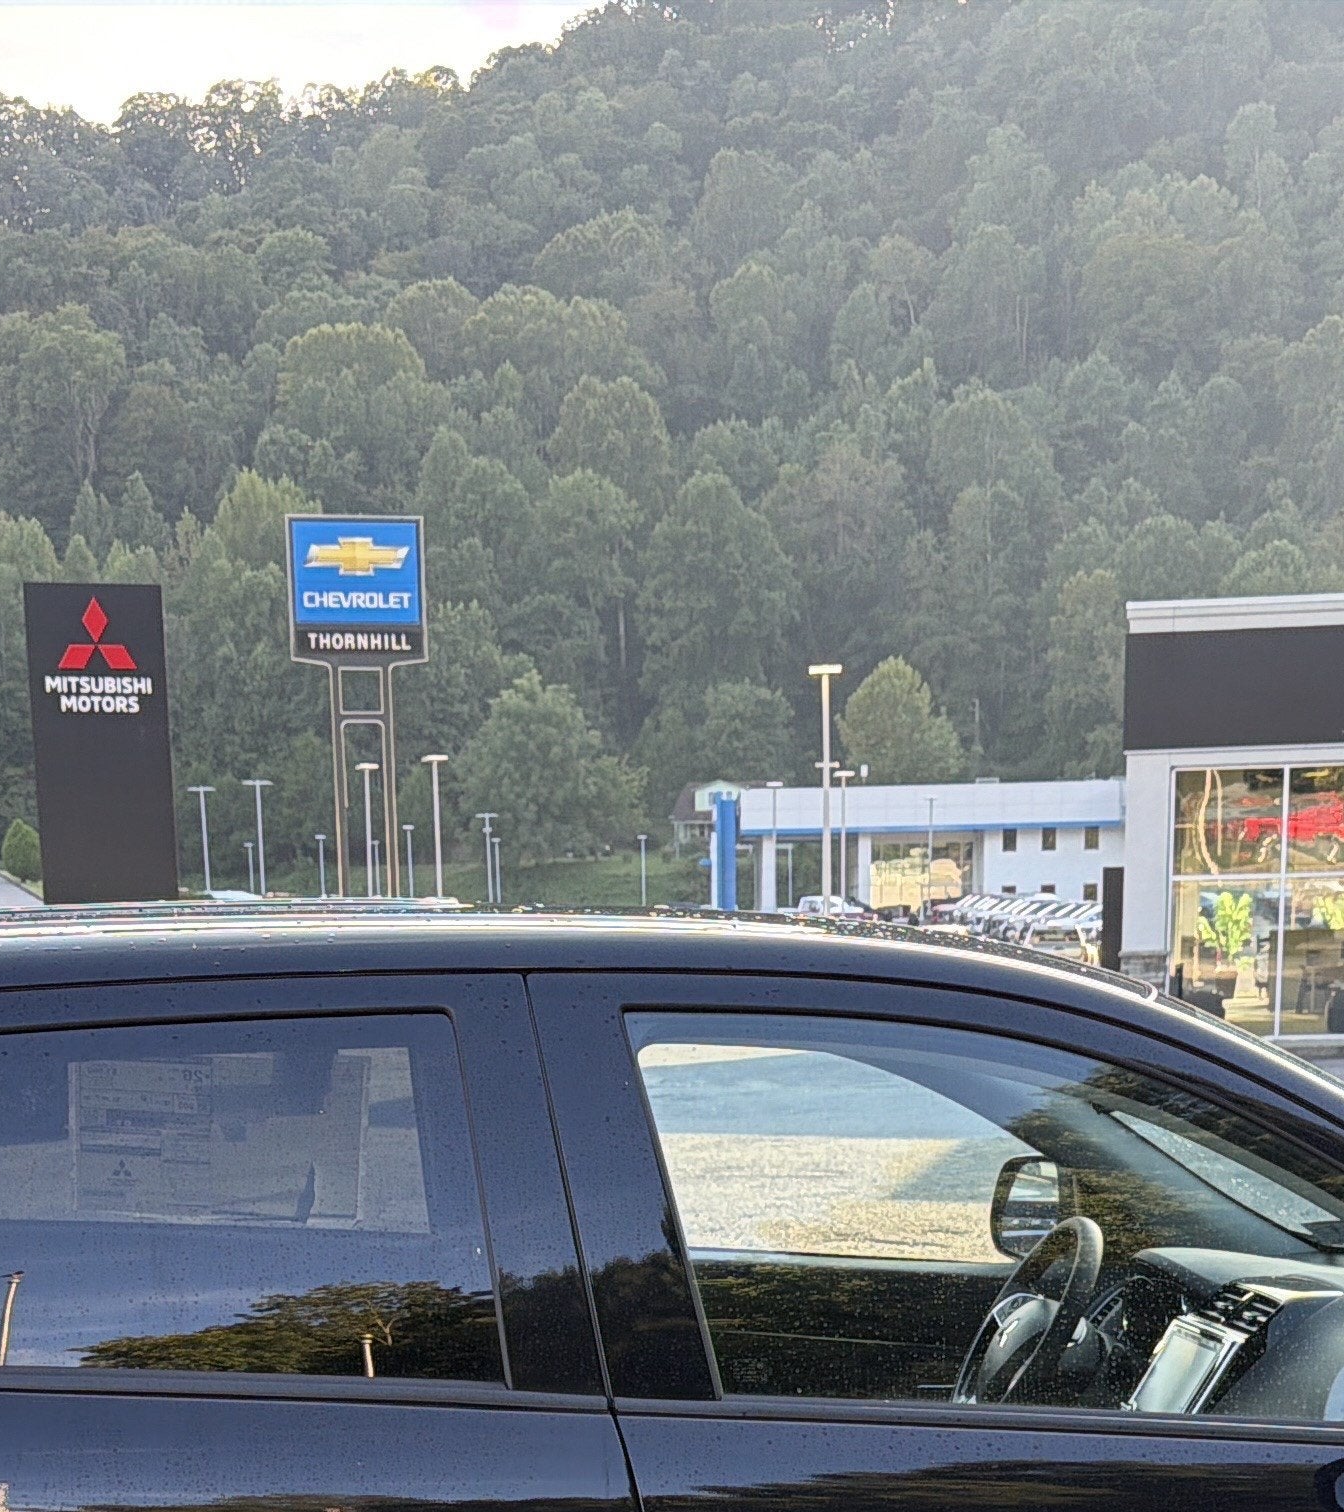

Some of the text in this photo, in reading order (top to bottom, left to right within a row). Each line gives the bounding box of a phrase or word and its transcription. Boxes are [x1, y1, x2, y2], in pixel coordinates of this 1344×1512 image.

[302, 590, 413, 610] CHEVROLET
[307, 632, 412, 651] THORNHILL
[44, 675, 153, 695] MITSUBISHI
[60, 695, 140, 713] MOTORS
